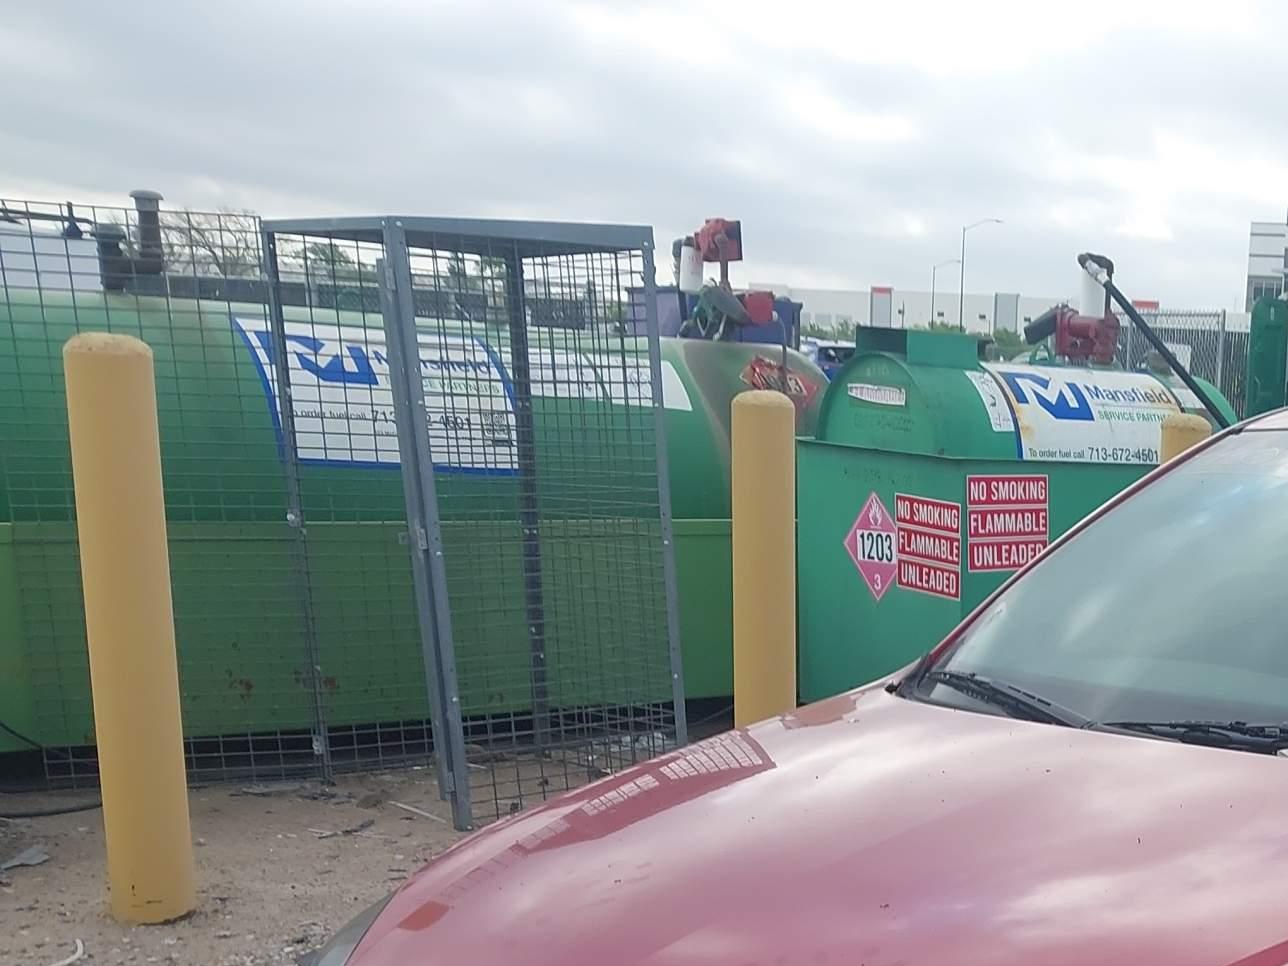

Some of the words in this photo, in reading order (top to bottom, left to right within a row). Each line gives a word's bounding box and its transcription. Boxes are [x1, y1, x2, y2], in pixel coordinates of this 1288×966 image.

[1083, 384, 1173, 404] Mansfield
[1098, 409, 1136, 421] SERVICE
[1028, 448, 1037, 457] To
[1039, 448, 1057, 458] order
[1059, 448, 1072, 458] fuel
[1072, 449, 1085, 459] call
[1087, 447, 1159, 463] 713-672-4501
[970, 483, 987, 501] NO
[991, 481, 1046, 501] SMOKING
[897, 500, 910, 520] NO
[913, 503, 959, 529] SMOKING
[970, 512, 1046, 534] FLAMMABLE
[859, 531, 894, 563] 1203
[899, 531, 959, 561] FLAMMABLE
[873, 574, 882, 591] 3
[901, 563, 957, 594] UNLEADED
